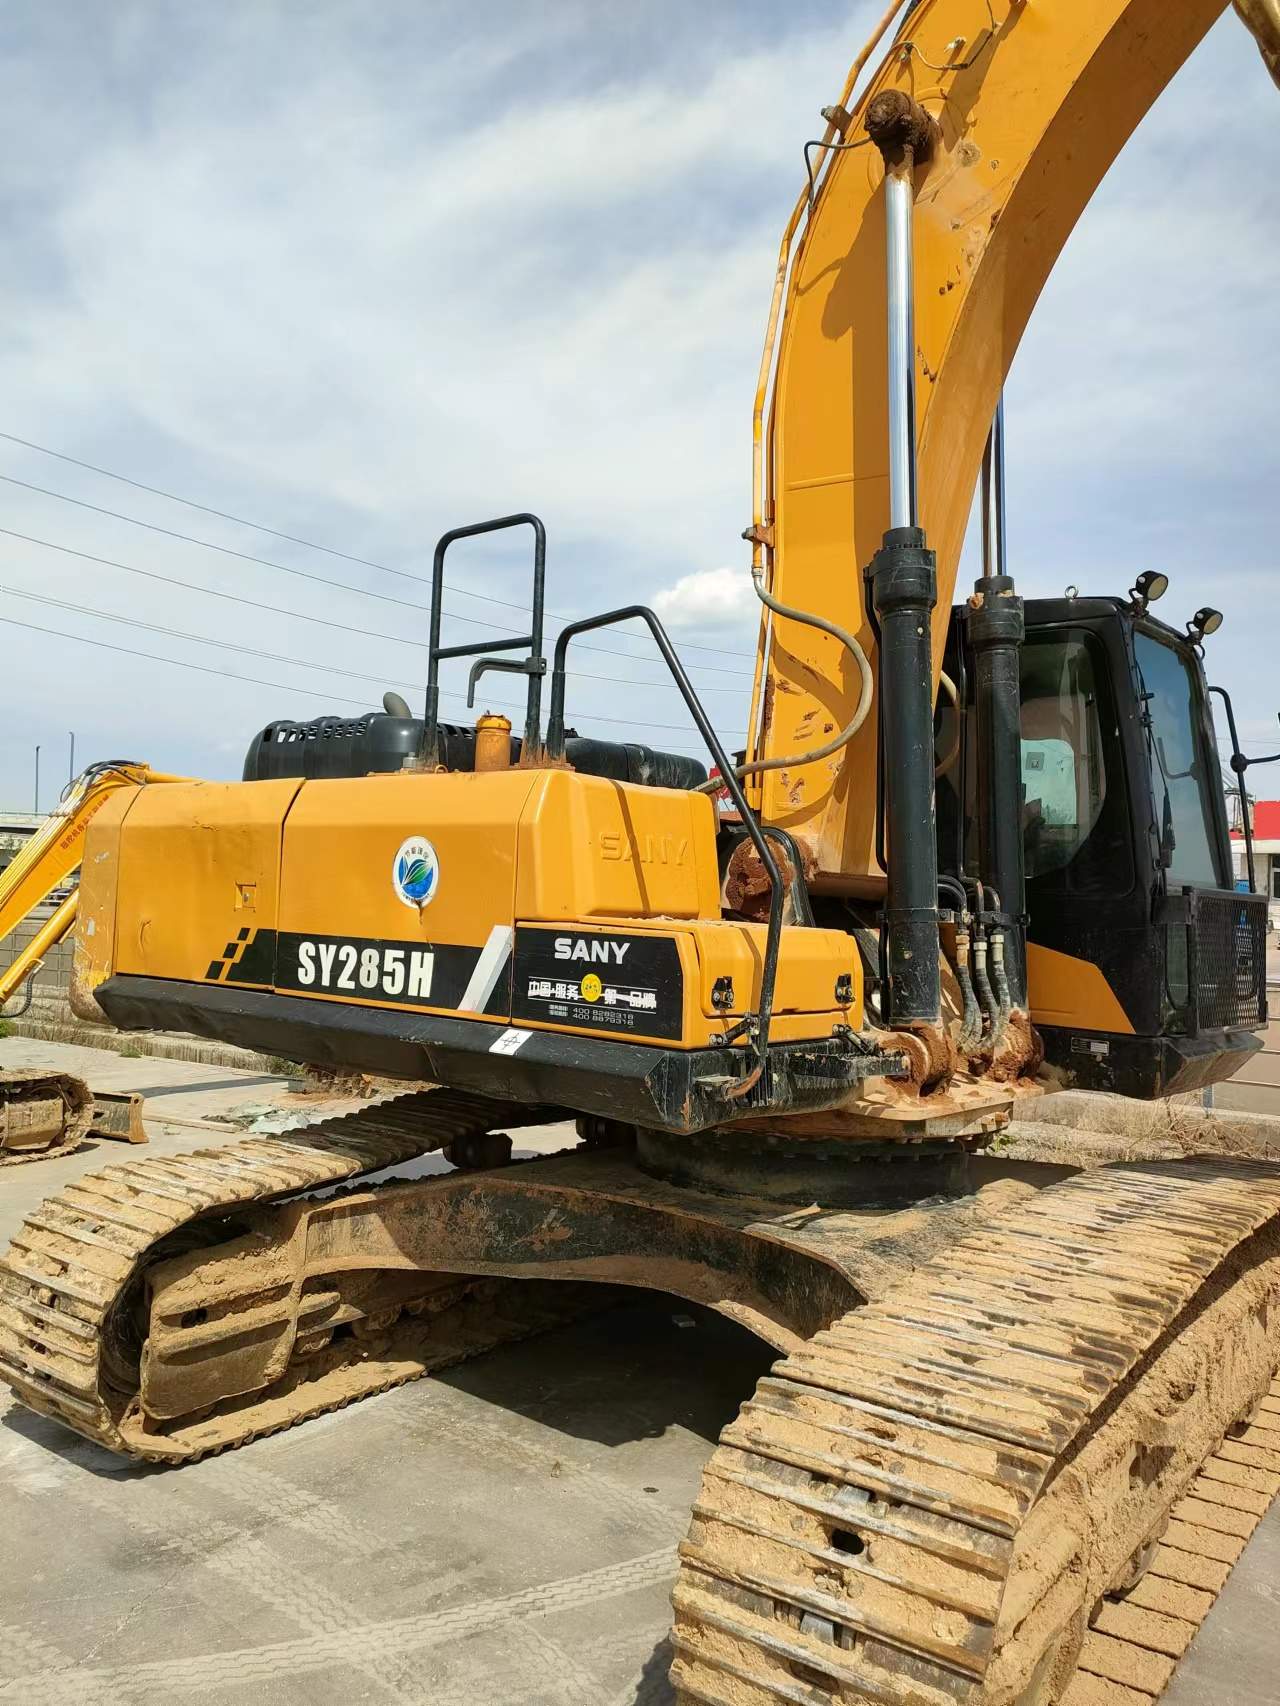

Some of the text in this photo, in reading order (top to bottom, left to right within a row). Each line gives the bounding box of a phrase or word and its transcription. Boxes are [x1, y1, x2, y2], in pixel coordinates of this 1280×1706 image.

[554, 938, 631, 965] SANY
[297, 941, 435, 998] SY285H
[572, 1007, 590, 1015] 400
[604, 988, 657, 1010] 第一品牌
